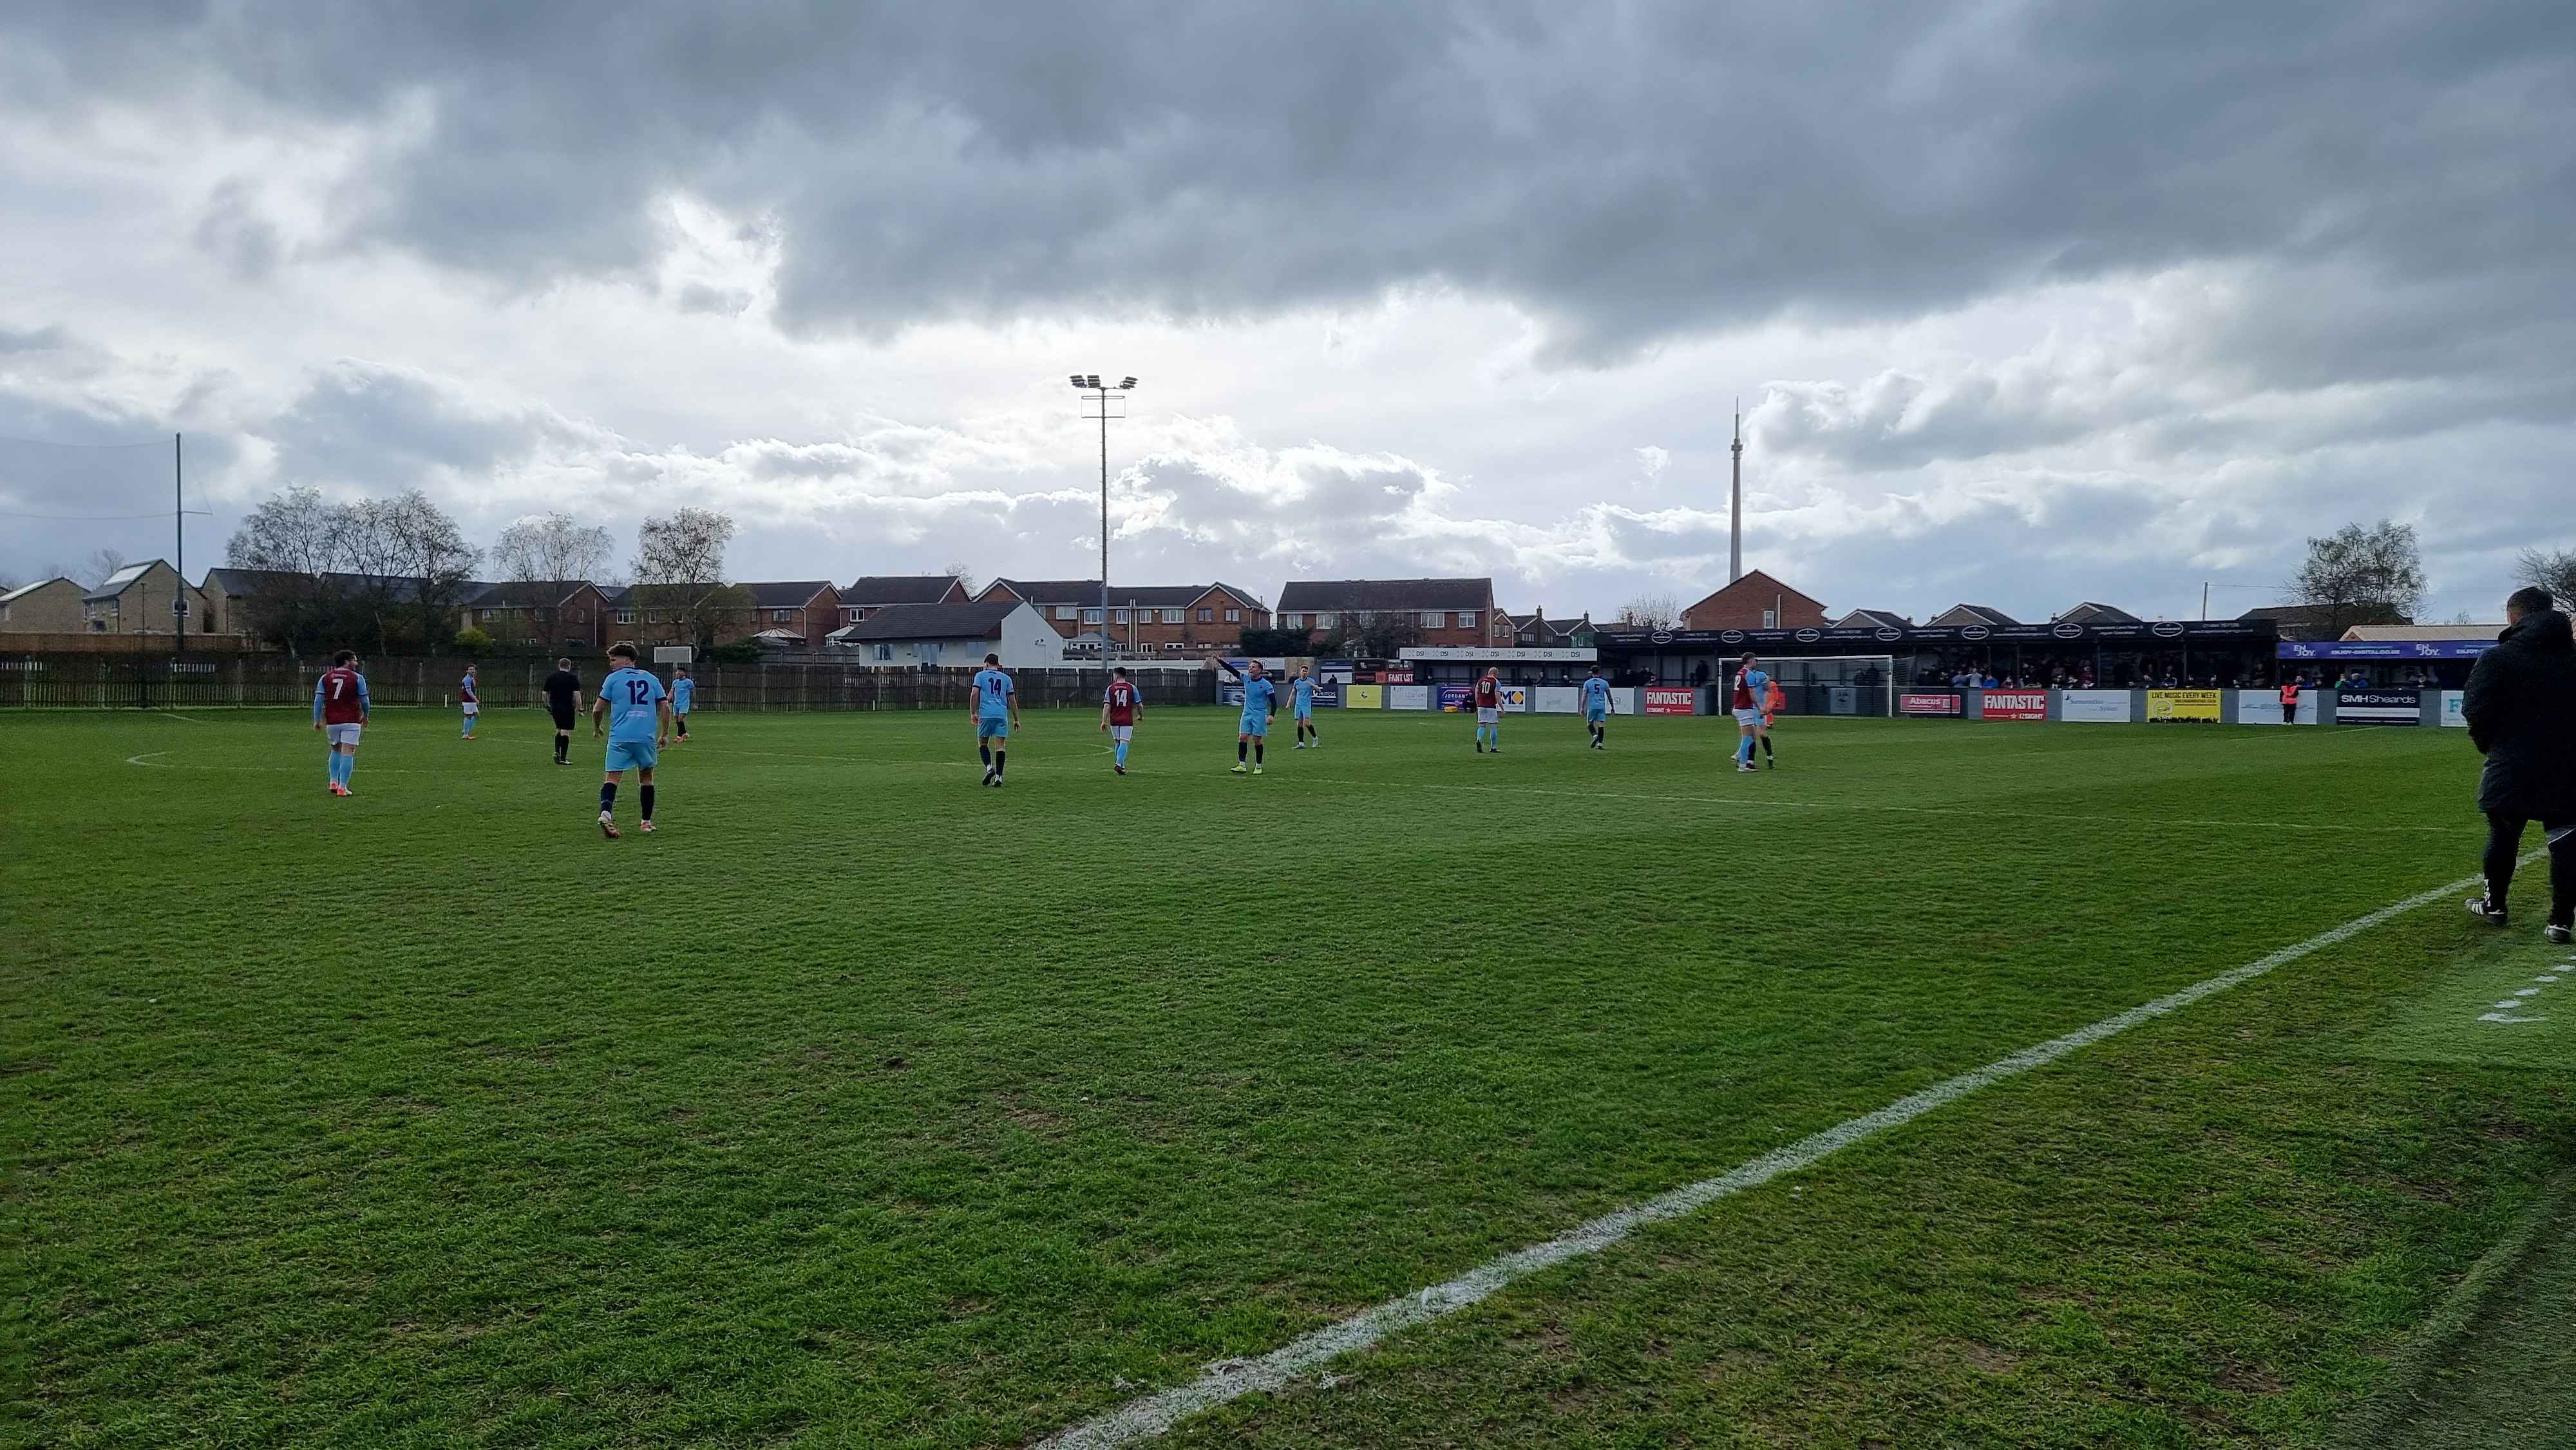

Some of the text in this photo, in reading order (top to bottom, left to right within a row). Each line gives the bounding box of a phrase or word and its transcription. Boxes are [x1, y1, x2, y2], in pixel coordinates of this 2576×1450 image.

[332, 678, 343, 700] 7
[625, 680, 649, 705] 12
[988, 677, 1001, 695] 14
[1481, 681, 1491, 694] 10
[1594, 684, 1600, 694] 5
[1114, 690, 1128, 707] 14
[1647, 692, 1691, 704] FANTASTIC
[1984, 695, 2045, 709] FANTASTIC
[2369, 695, 2416, 703] Sheards
